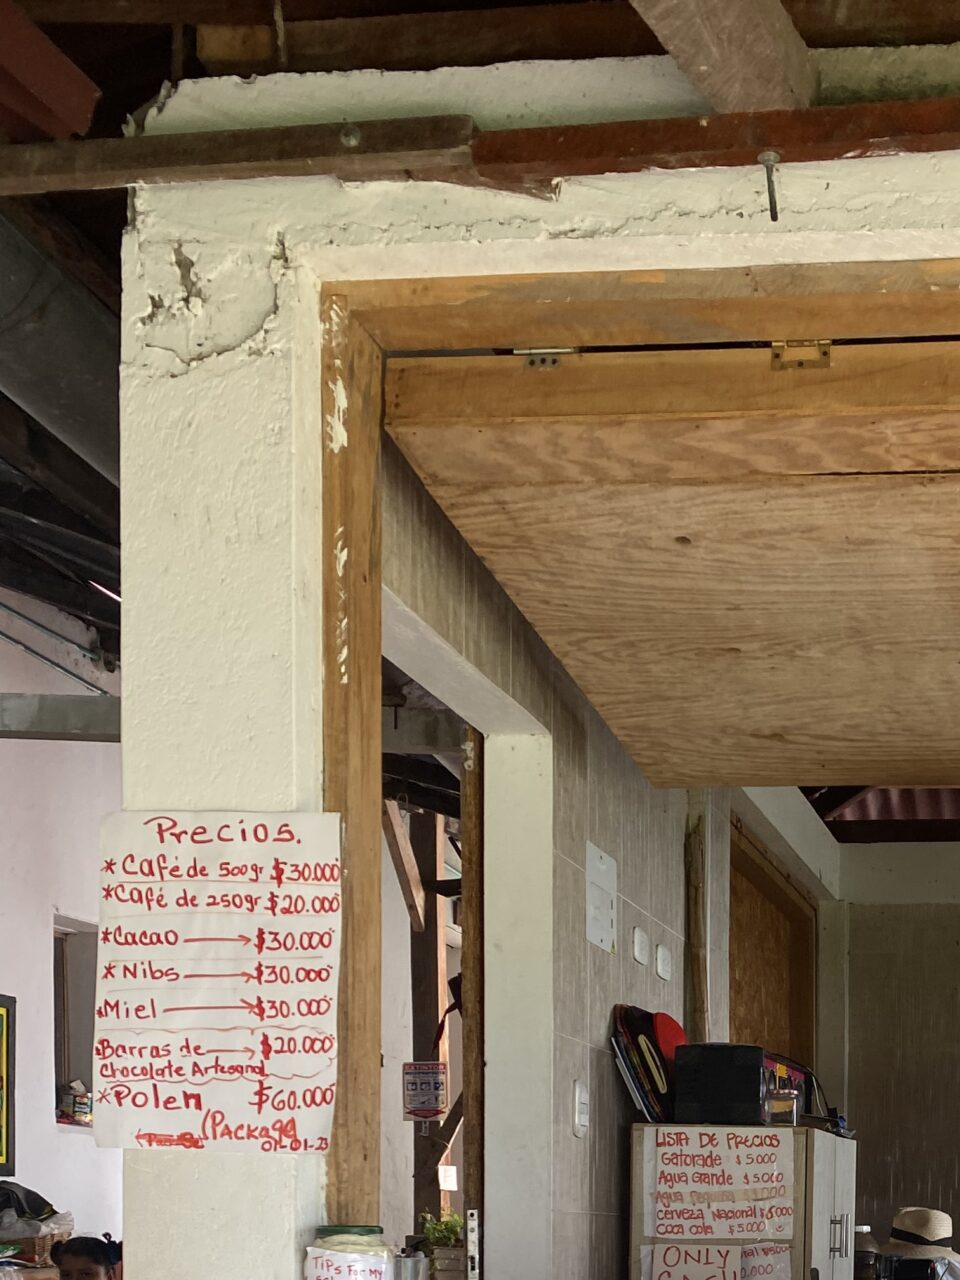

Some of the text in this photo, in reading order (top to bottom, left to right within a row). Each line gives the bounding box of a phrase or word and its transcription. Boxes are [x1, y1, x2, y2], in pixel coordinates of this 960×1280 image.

[186, 857, 209, 878] de
[175, 890, 199, 907] de
[123, 961, 180, 981] Nibs
[180, 1038, 205, 1057] de
[109, 1084, 202, 1110] Polen
[656, 1128, 780, 1150] LISTA DE PRECIOS
[661, 1149, 722, 1168] Gatorade
[658, 1170, 688, 1189] Agua
[692, 1169, 733, 1186] Grande
[663, 1245, 730, 1269] ONLY
